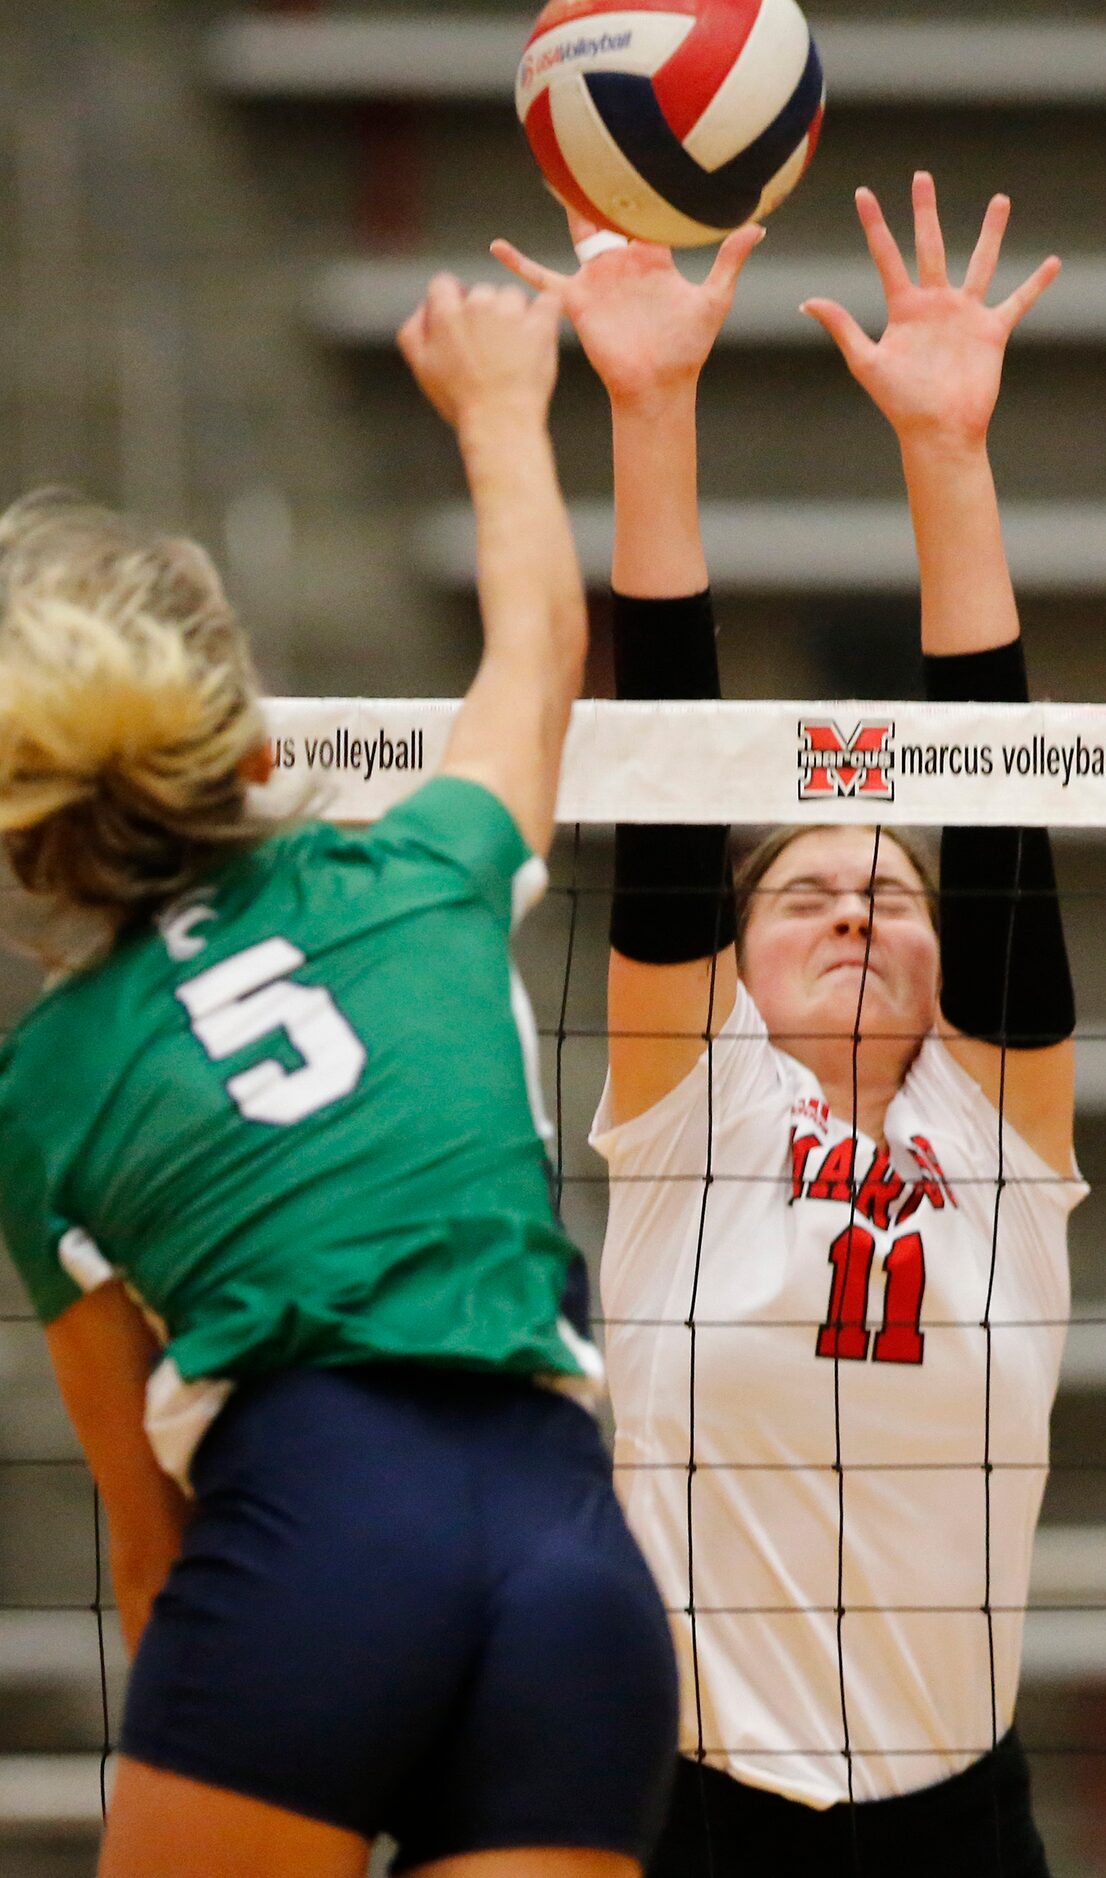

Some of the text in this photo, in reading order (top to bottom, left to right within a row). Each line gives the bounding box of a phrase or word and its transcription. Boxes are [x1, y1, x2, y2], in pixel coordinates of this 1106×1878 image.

[304, 728, 424, 781] volleyball
[901, 744, 993, 776] marcus
[175, 935, 368, 1126] 5
[815, 1224, 926, 1365] 11
